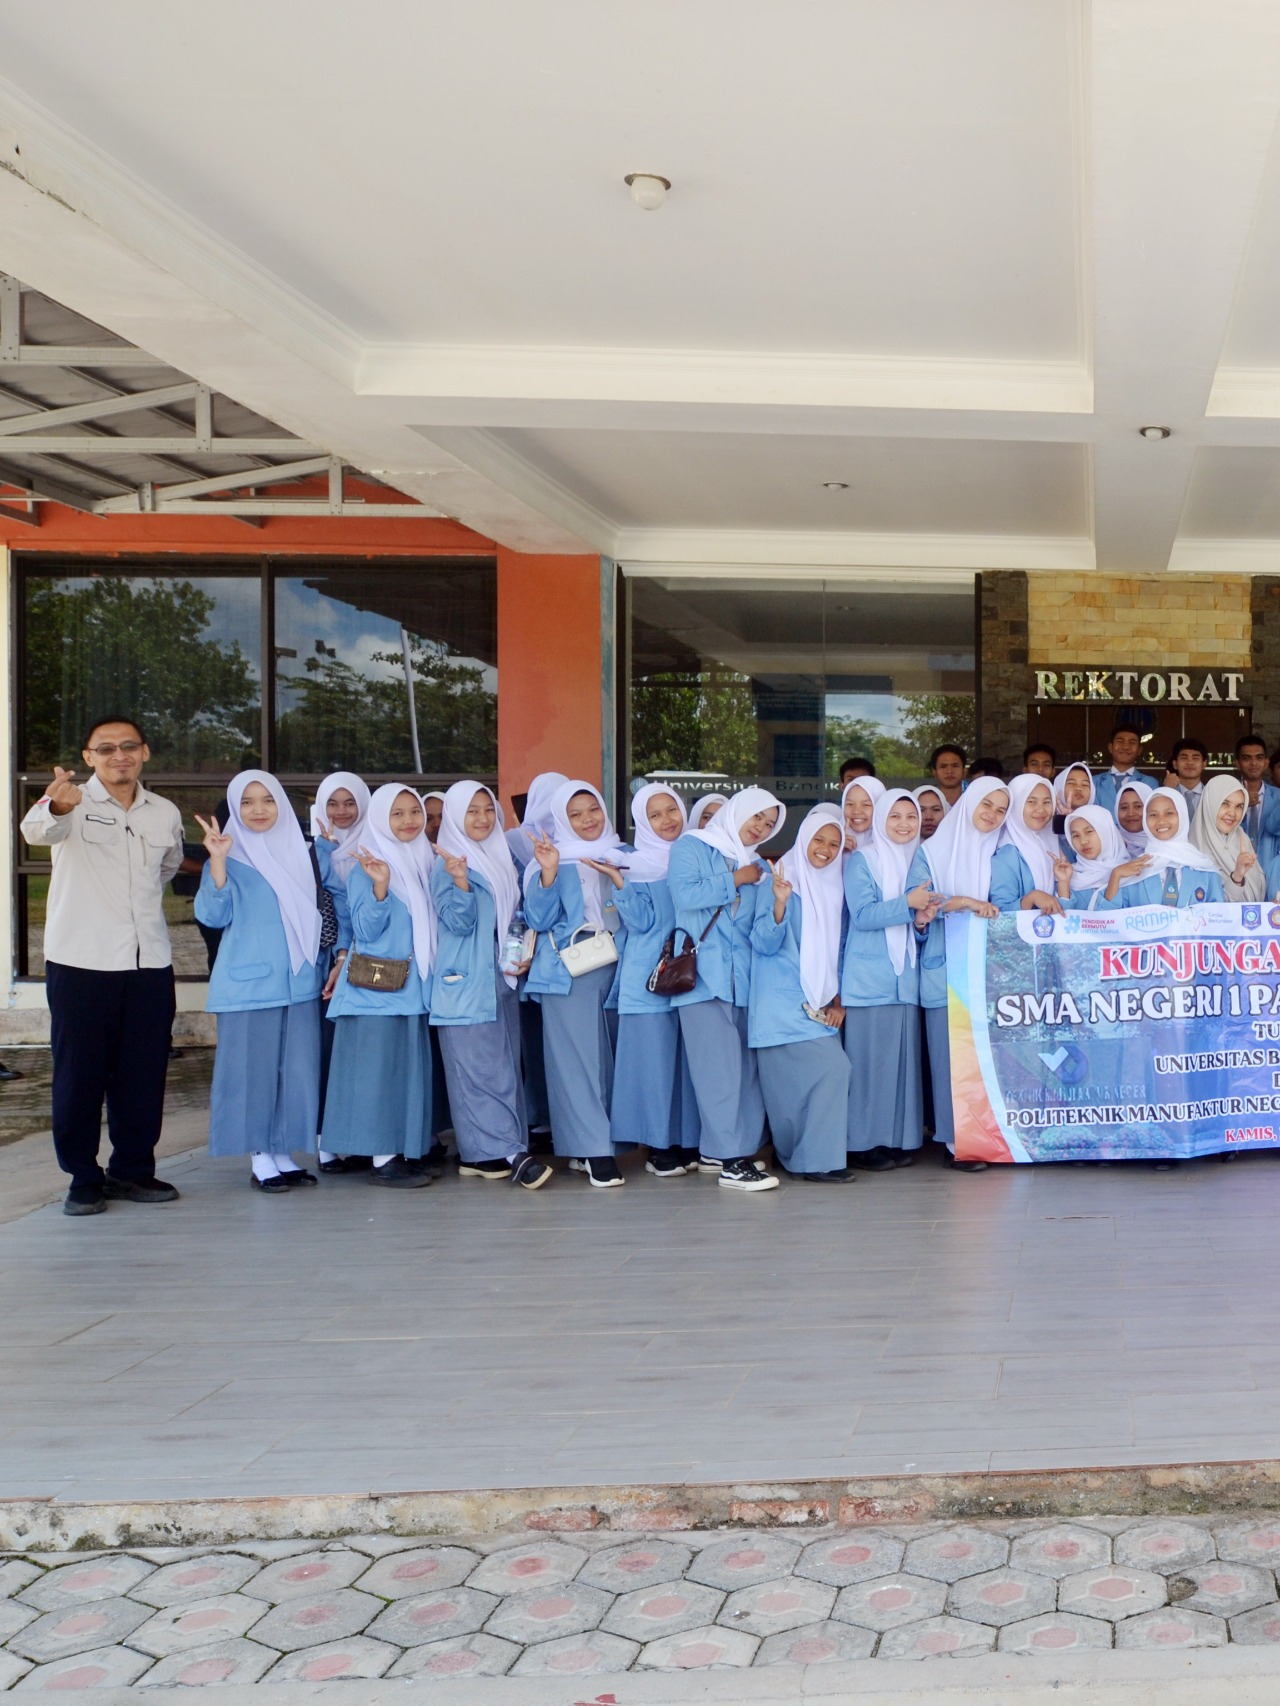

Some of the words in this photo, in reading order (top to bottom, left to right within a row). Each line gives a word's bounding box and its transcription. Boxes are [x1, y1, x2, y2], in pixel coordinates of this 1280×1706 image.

[1034, 670, 1244, 701] REKTORAT
[1125, 910, 1179, 929] RAMAH
[997, 992, 1082, 1027] SMA
[1089, 984, 1222, 1023] NEGERI
[1228, 983, 1242, 1017] 1
[1155, 1050, 1264, 1073] UNIVERSITAS
[1006, 1107, 1124, 1127] POLITEKNIK
[1128, 1098, 1242, 1122] MANUFAKTUR
[1225, 1128, 1277, 1143] KAMIS,
